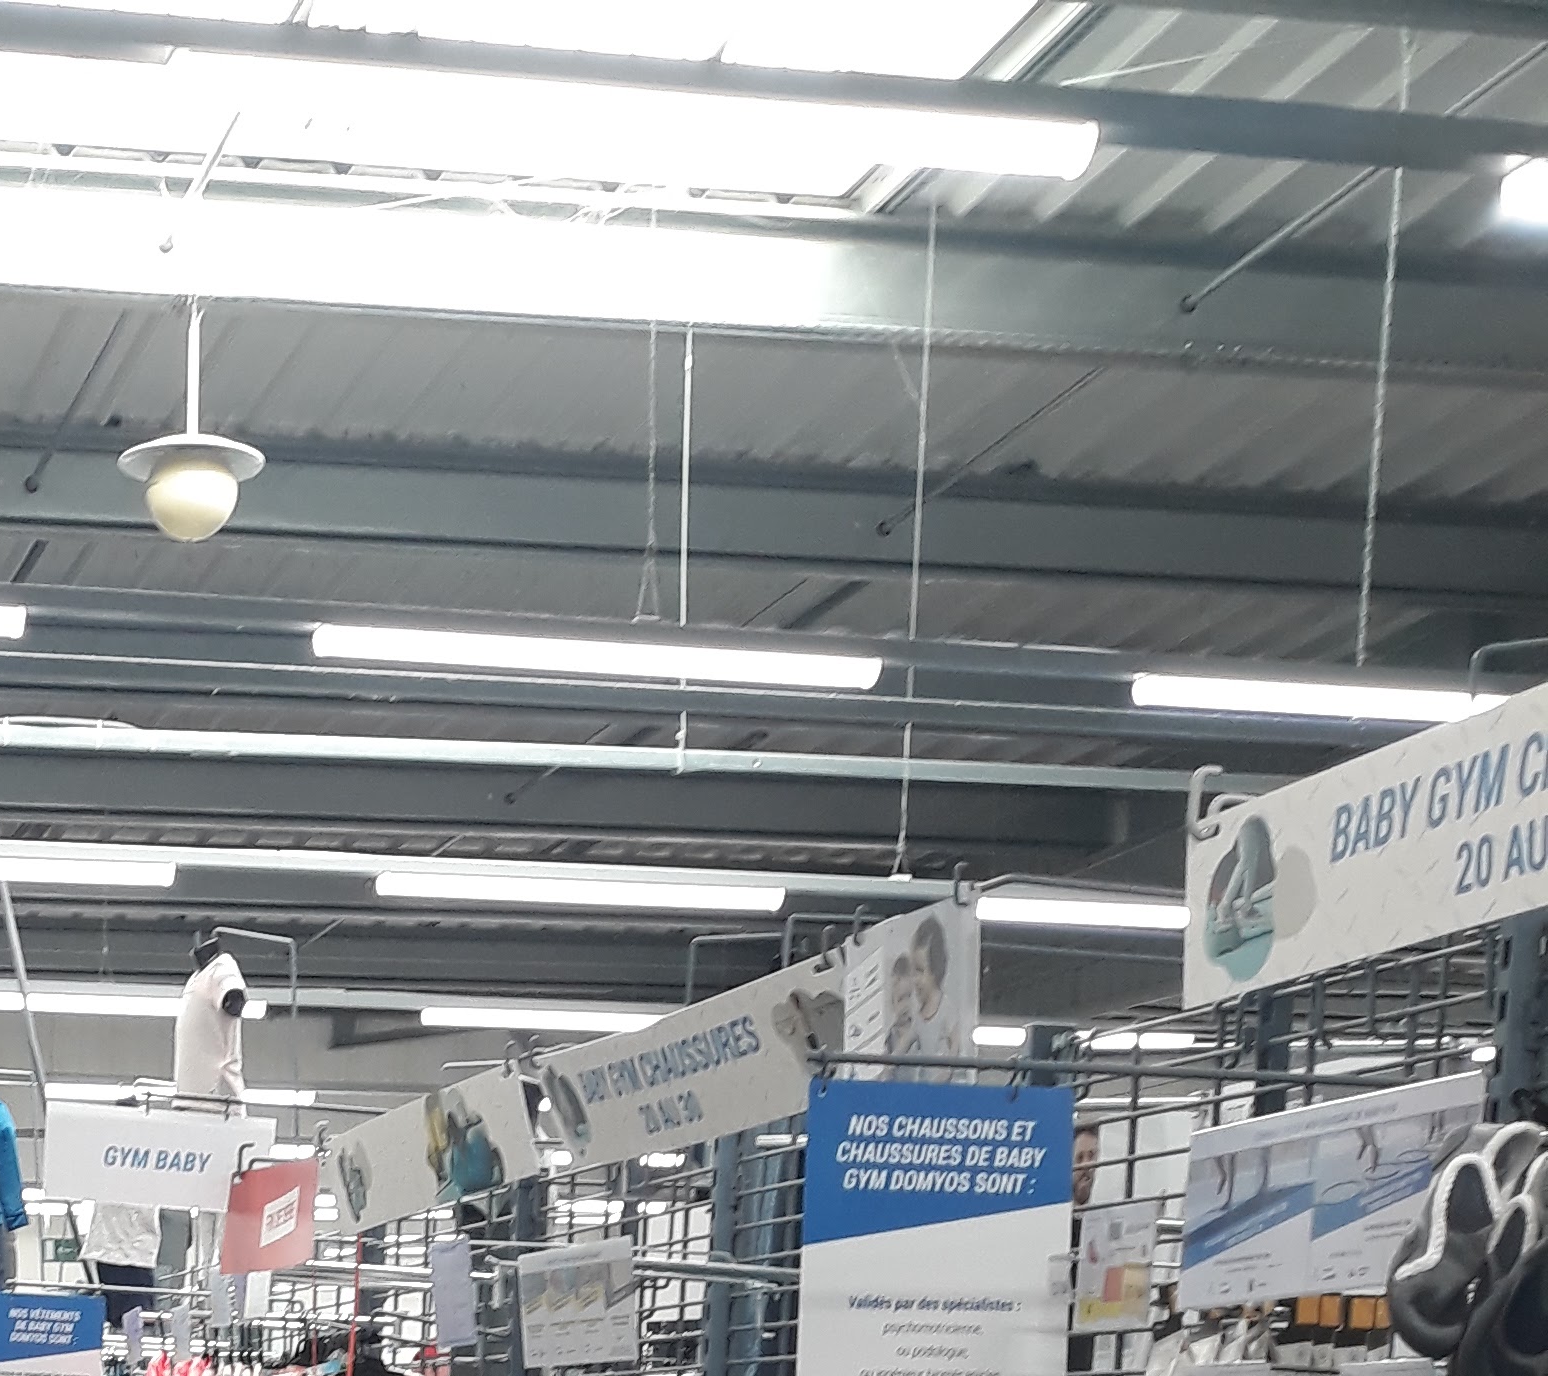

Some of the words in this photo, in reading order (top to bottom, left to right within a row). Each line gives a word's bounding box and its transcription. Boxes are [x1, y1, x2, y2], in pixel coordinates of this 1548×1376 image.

[1330, 776, 1423, 864] BABY
[1428, 743, 1511, 830] GYM
[1519, 731, 1548, 798] C
[1454, 833, 1493, 896] 20
[847, 1114, 888, 1137] NOS
[892, 1115, 1008, 1141] CHAUSSONS
[1010, 1120, 1037, 1142] ET
[103, 1145, 152, 1170] GYM
[154, 1149, 213, 1174] BABY
[835, 1141, 964, 1166] CHAUSSURES
[965, 1146, 990, 1166] DE
[993, 1147, 1047, 1169] BABY
[842, 1168, 886, 1191] GYM
[890, 1170, 972, 1193] DOMYOS
[974, 1172, 1028, 1194] SONT
